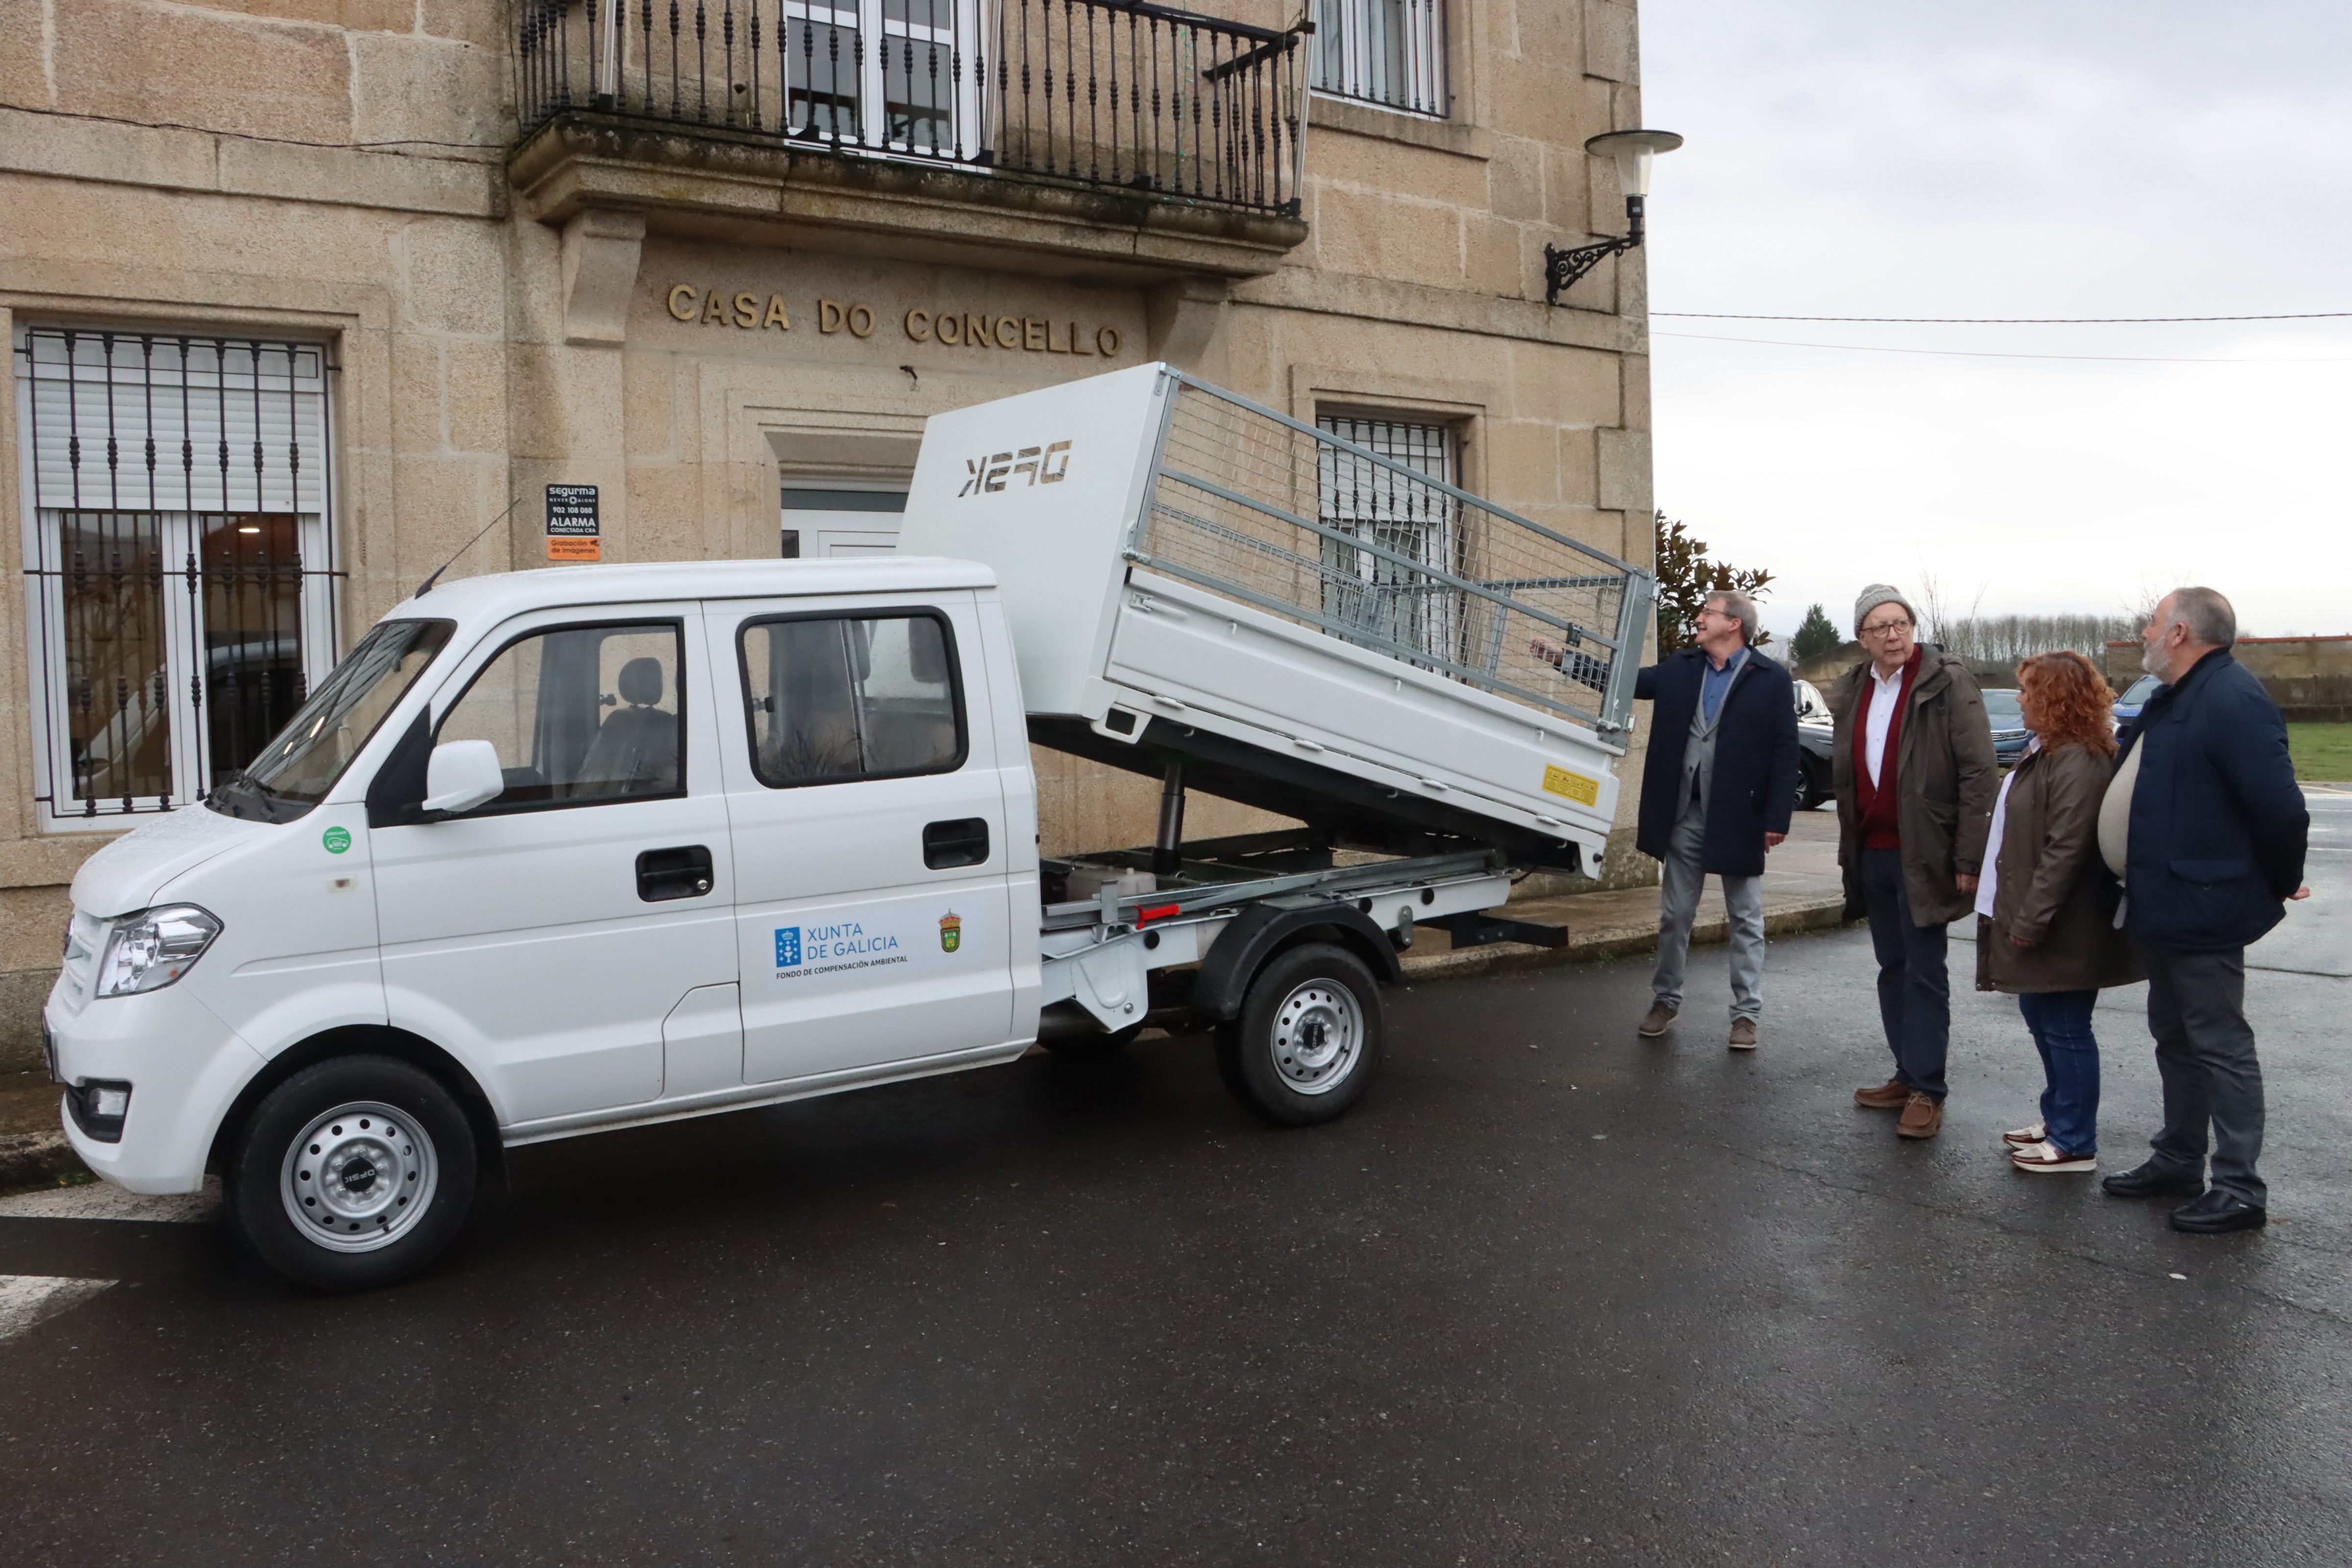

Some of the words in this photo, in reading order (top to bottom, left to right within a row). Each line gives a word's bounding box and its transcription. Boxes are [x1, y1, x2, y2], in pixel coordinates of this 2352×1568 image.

[667, 284, 790, 330] CASA
[819, 299, 877, 339] DO
[905, 308, 1124, 357] CONCELLO
[549, 487, 595, 496] segurma
[550, 517, 596, 527] ALARMA
[807, 923, 863, 942] XUNTA
[808, 945, 827, 959] DE
[834, 936, 898, 956] GALICIA
[776, 971, 802, 980] FONDO
[814, 959, 869, 974] COMPENSACIÓN
[870, 956, 908, 966] AMBIENTAL
[344, 1169, 375, 1183] DFSK
